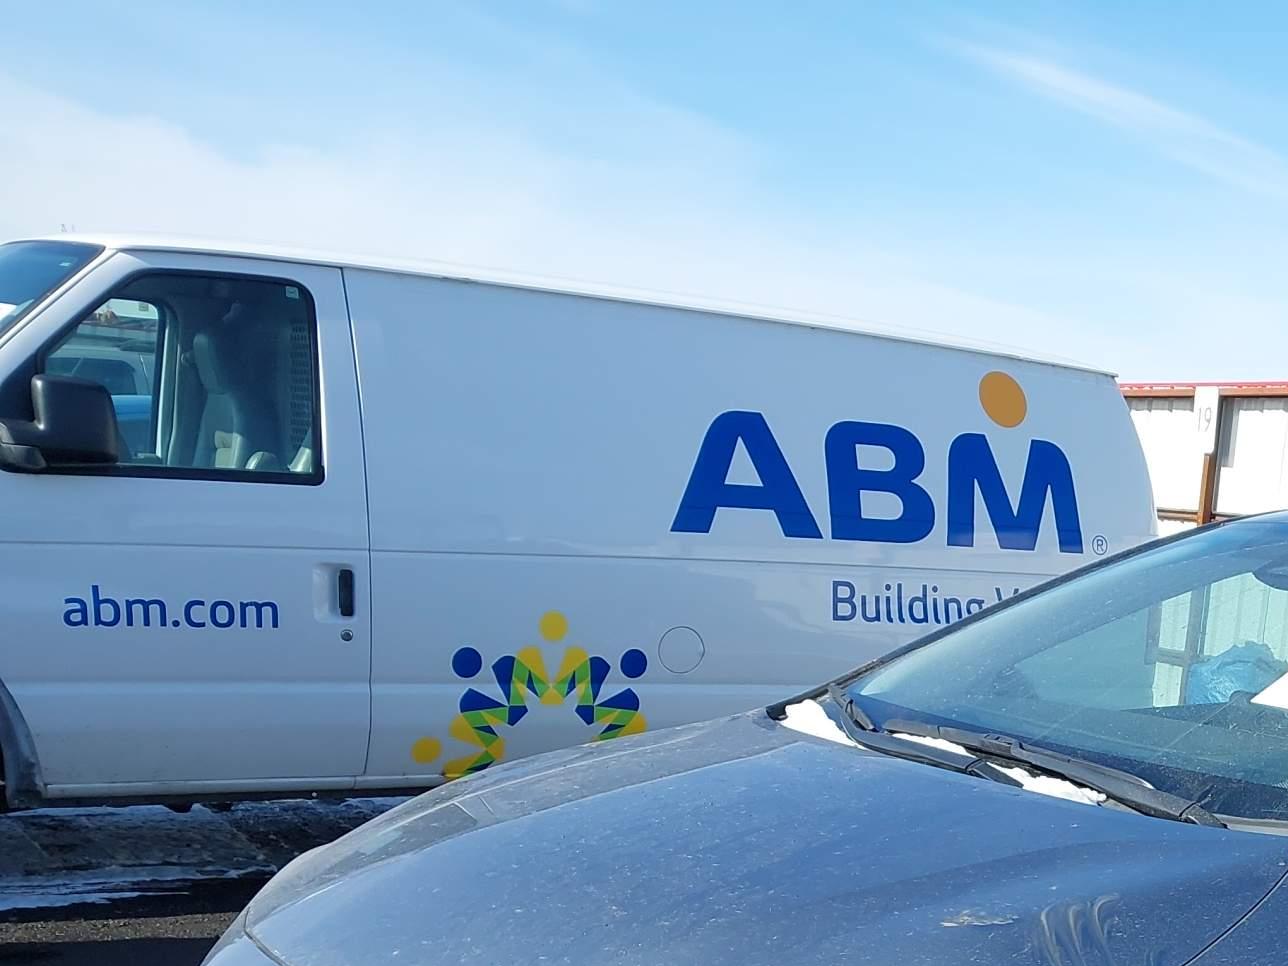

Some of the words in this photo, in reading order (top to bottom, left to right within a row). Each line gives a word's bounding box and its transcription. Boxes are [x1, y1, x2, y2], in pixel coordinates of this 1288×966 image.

[1197, 407, 1212, 432] 19
[670, 410, 1084, 553] ABM
[63, 585, 279, 629] abm.com
